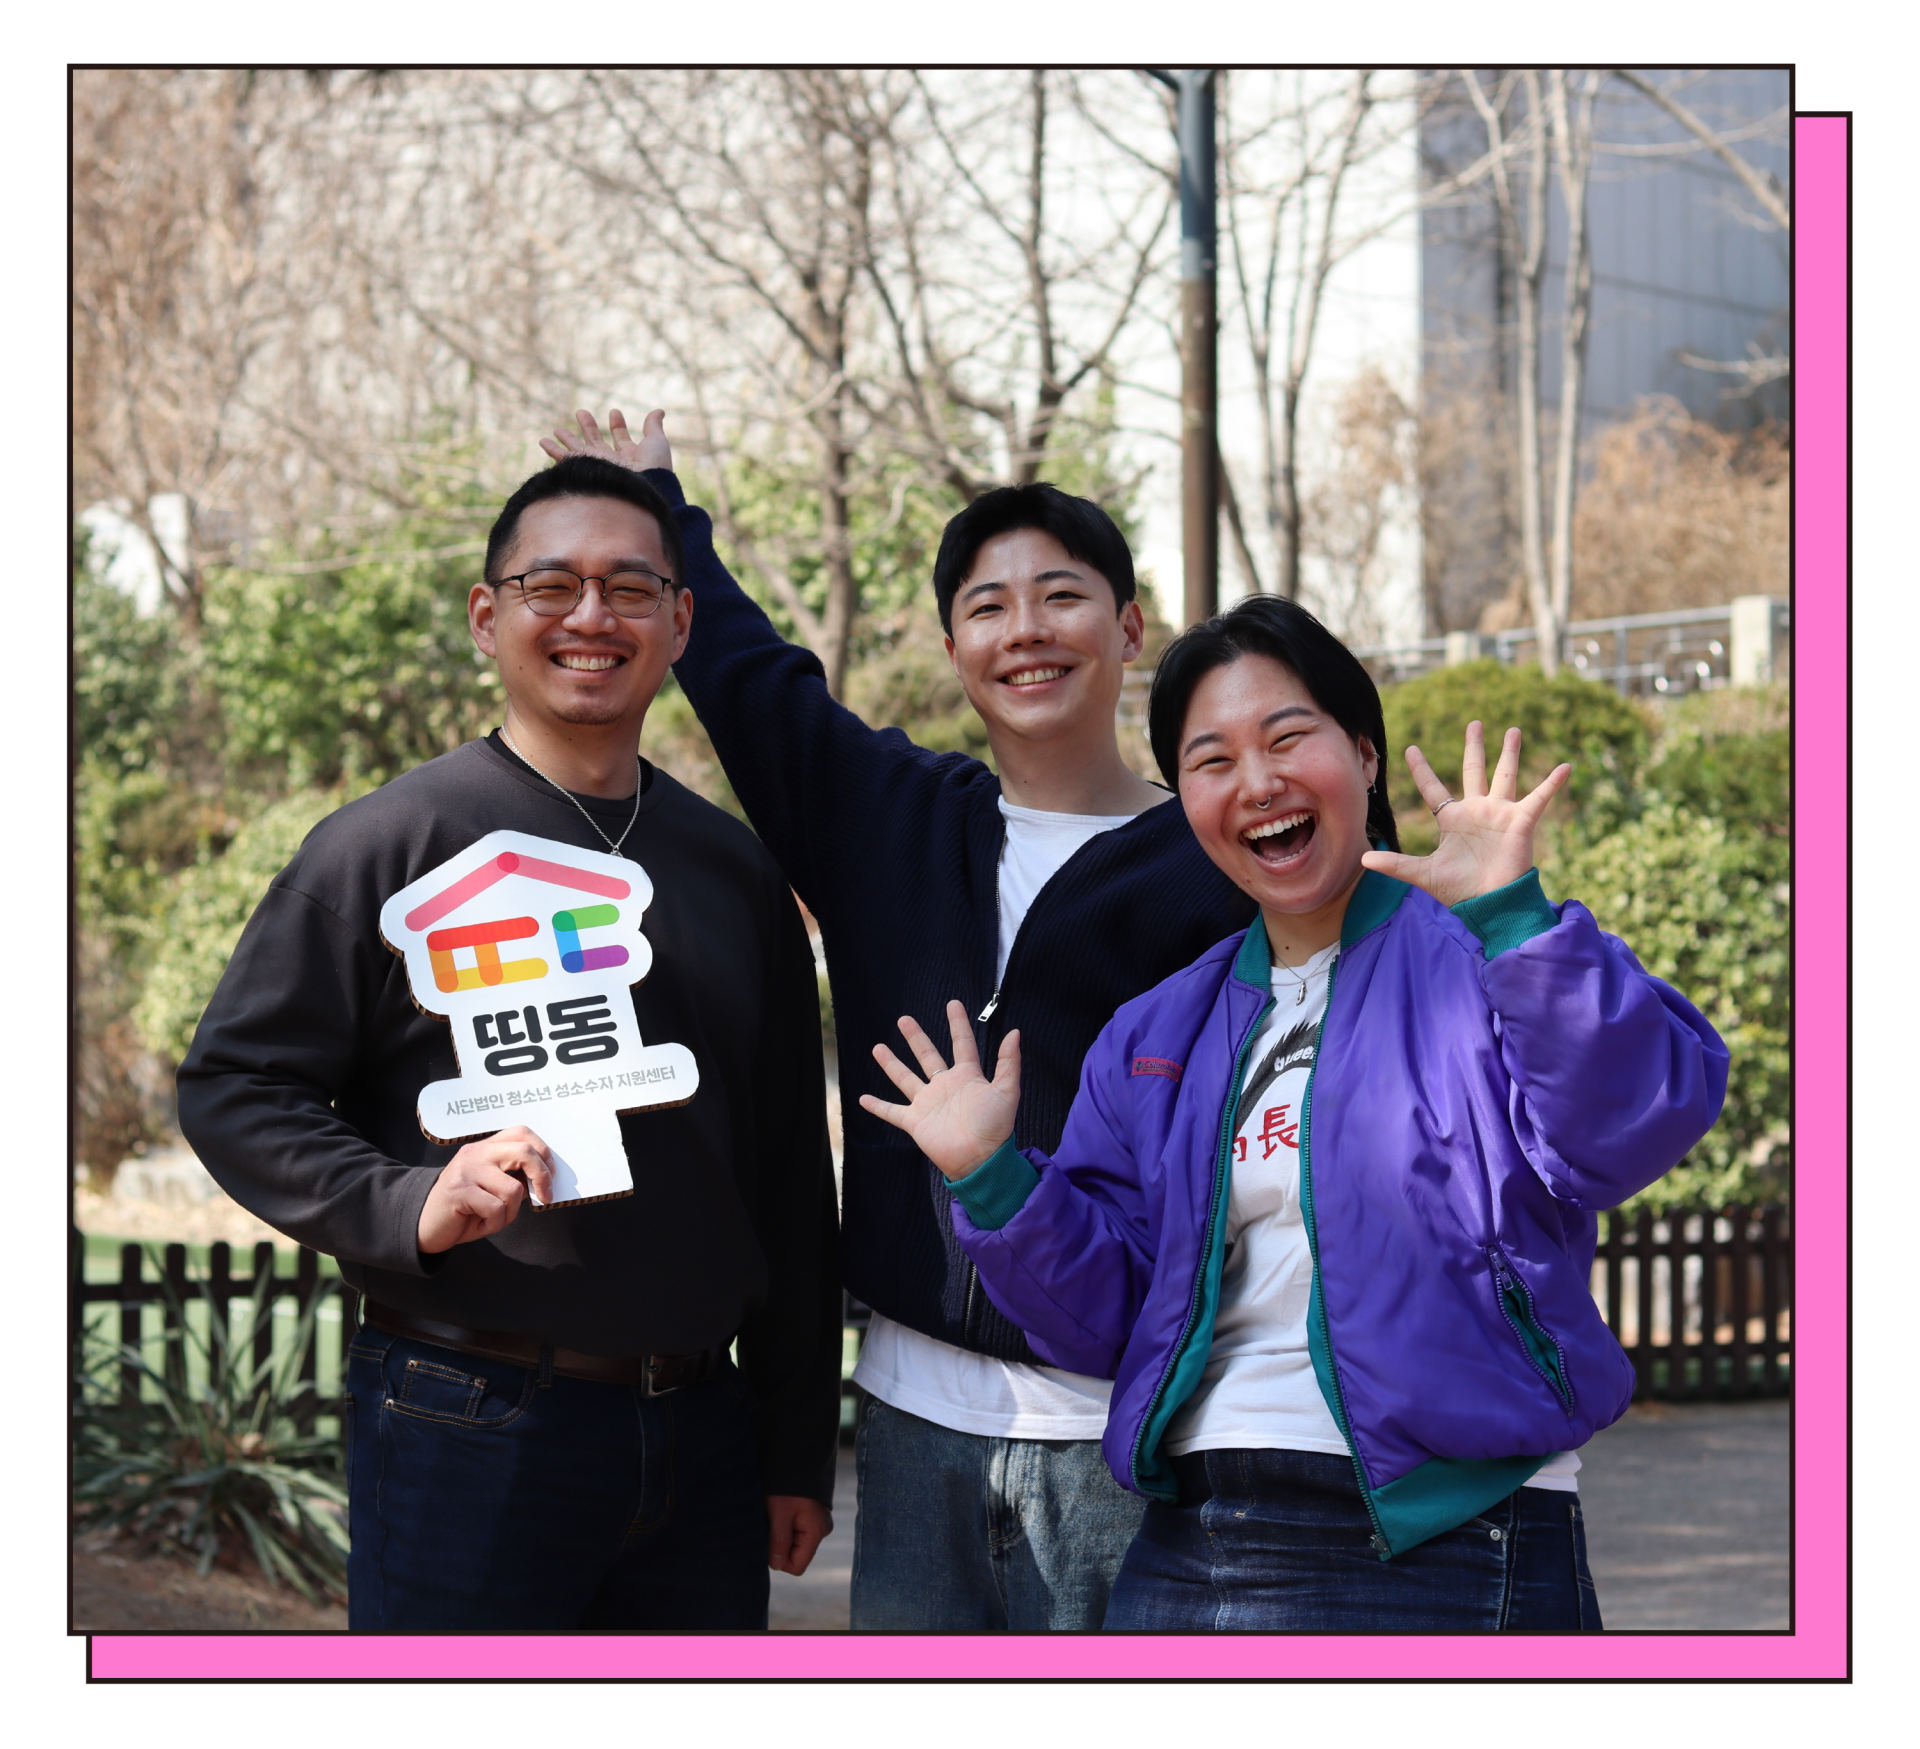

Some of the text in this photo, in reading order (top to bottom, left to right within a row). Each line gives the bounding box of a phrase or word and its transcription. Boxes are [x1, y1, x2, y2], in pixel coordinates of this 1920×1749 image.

[472, 994, 619, 1077] 띵동
[446, 1065, 676, 1116] 사단법인 청소년 성소수자 지원센터
